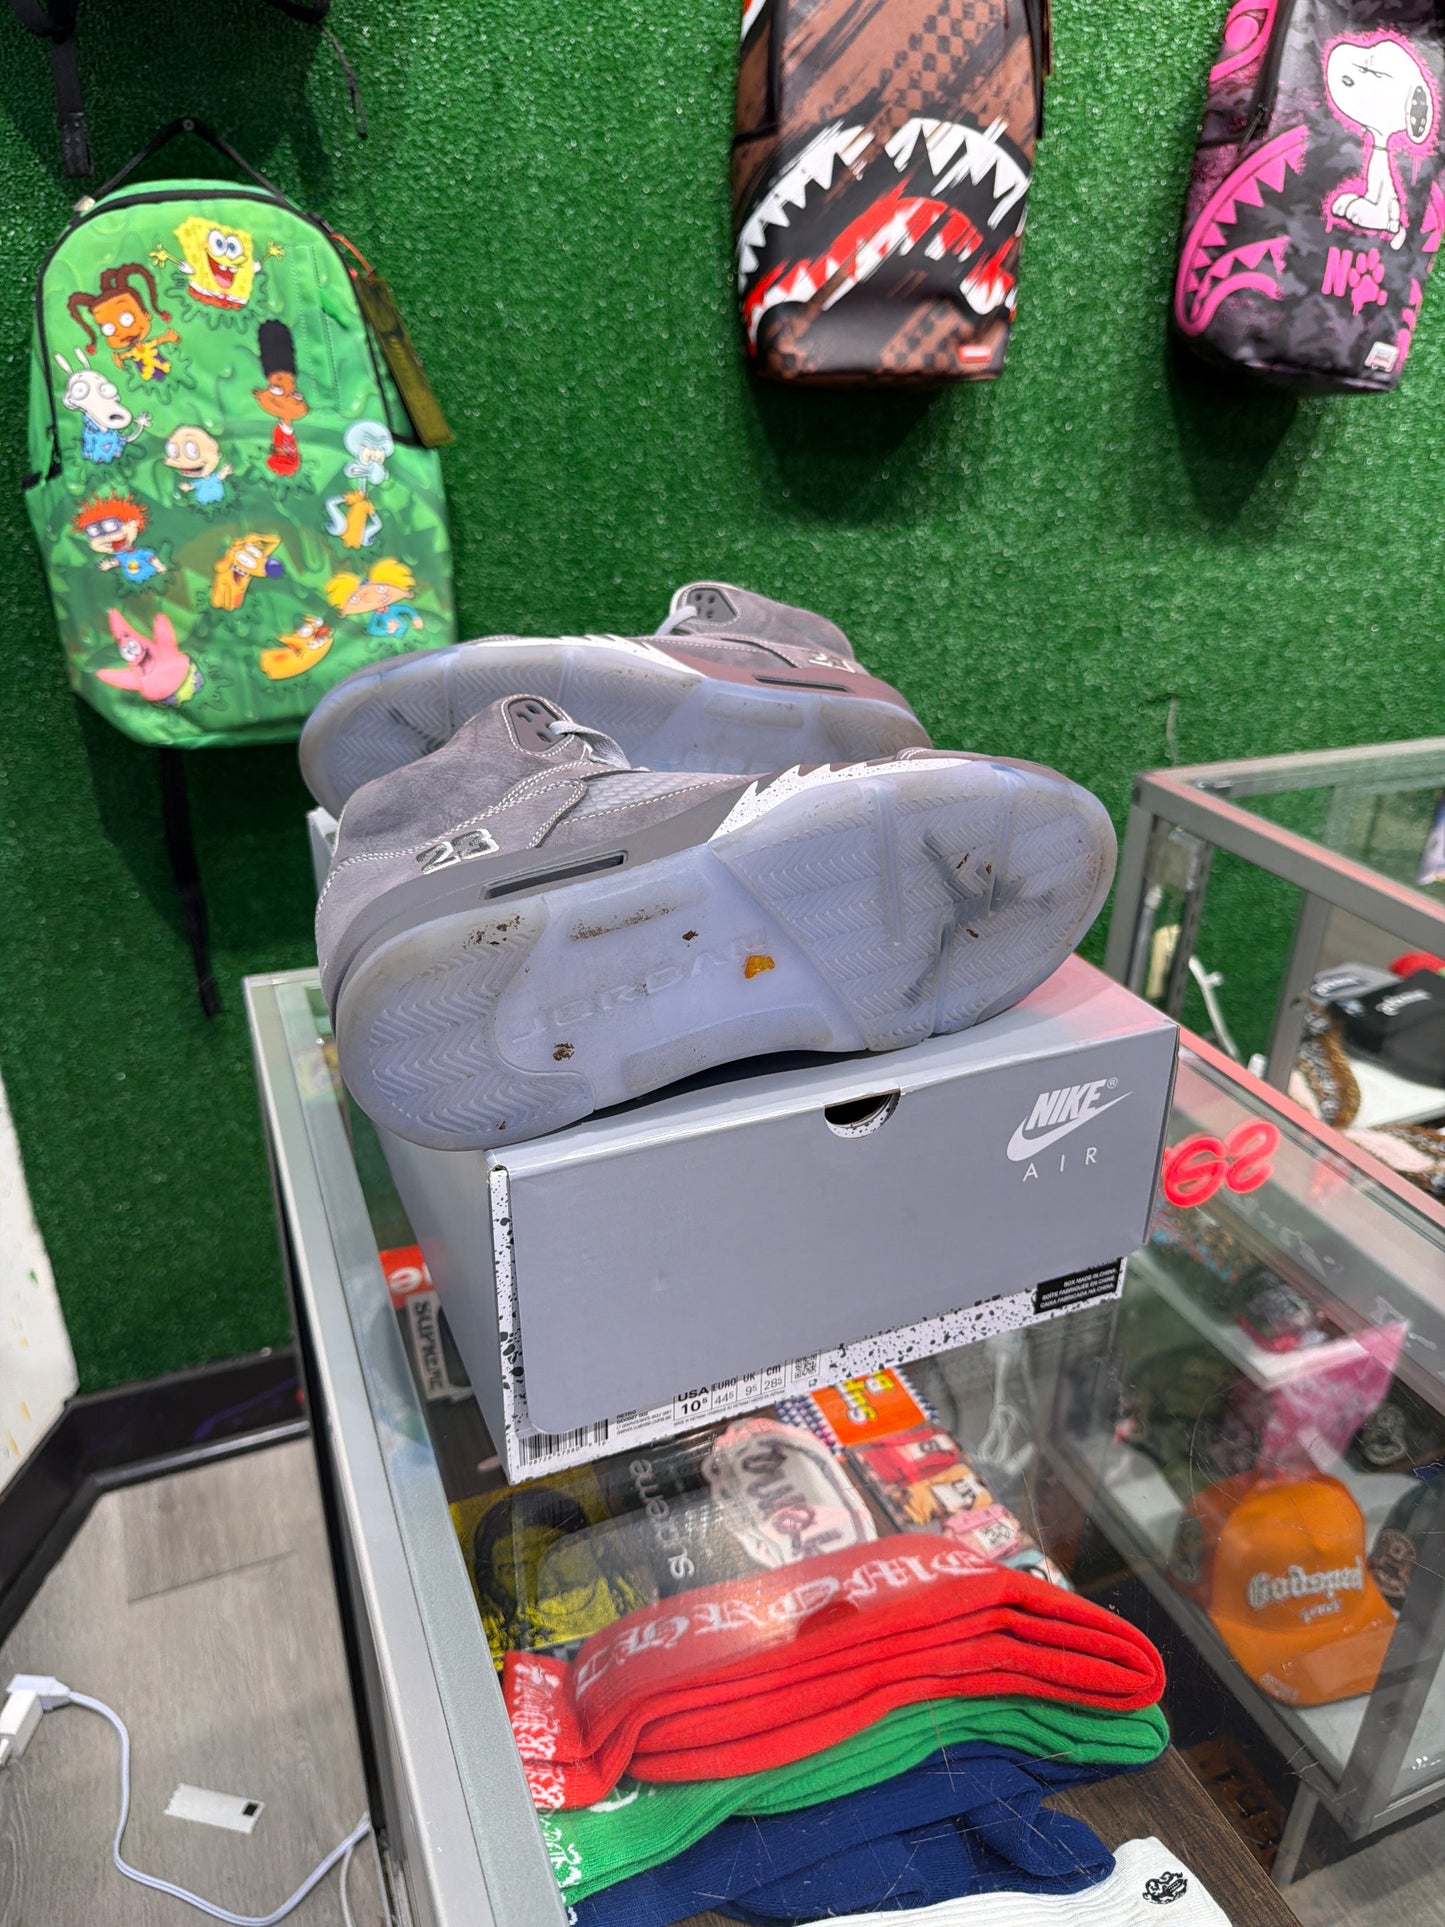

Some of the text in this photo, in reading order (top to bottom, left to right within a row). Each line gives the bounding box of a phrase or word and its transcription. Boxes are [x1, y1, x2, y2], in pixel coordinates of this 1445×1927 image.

[415, 828, 499, 875] 23
[1025, 1079, 1107, 1131] NIKE
[1022, 1147, 1097, 1182] AIR
[1064, 1279, 1075, 1288] BOX
[1091, 1272, 1099, 1280] IN
[678, 1363, 781, 1401] USA EURO UK cm
